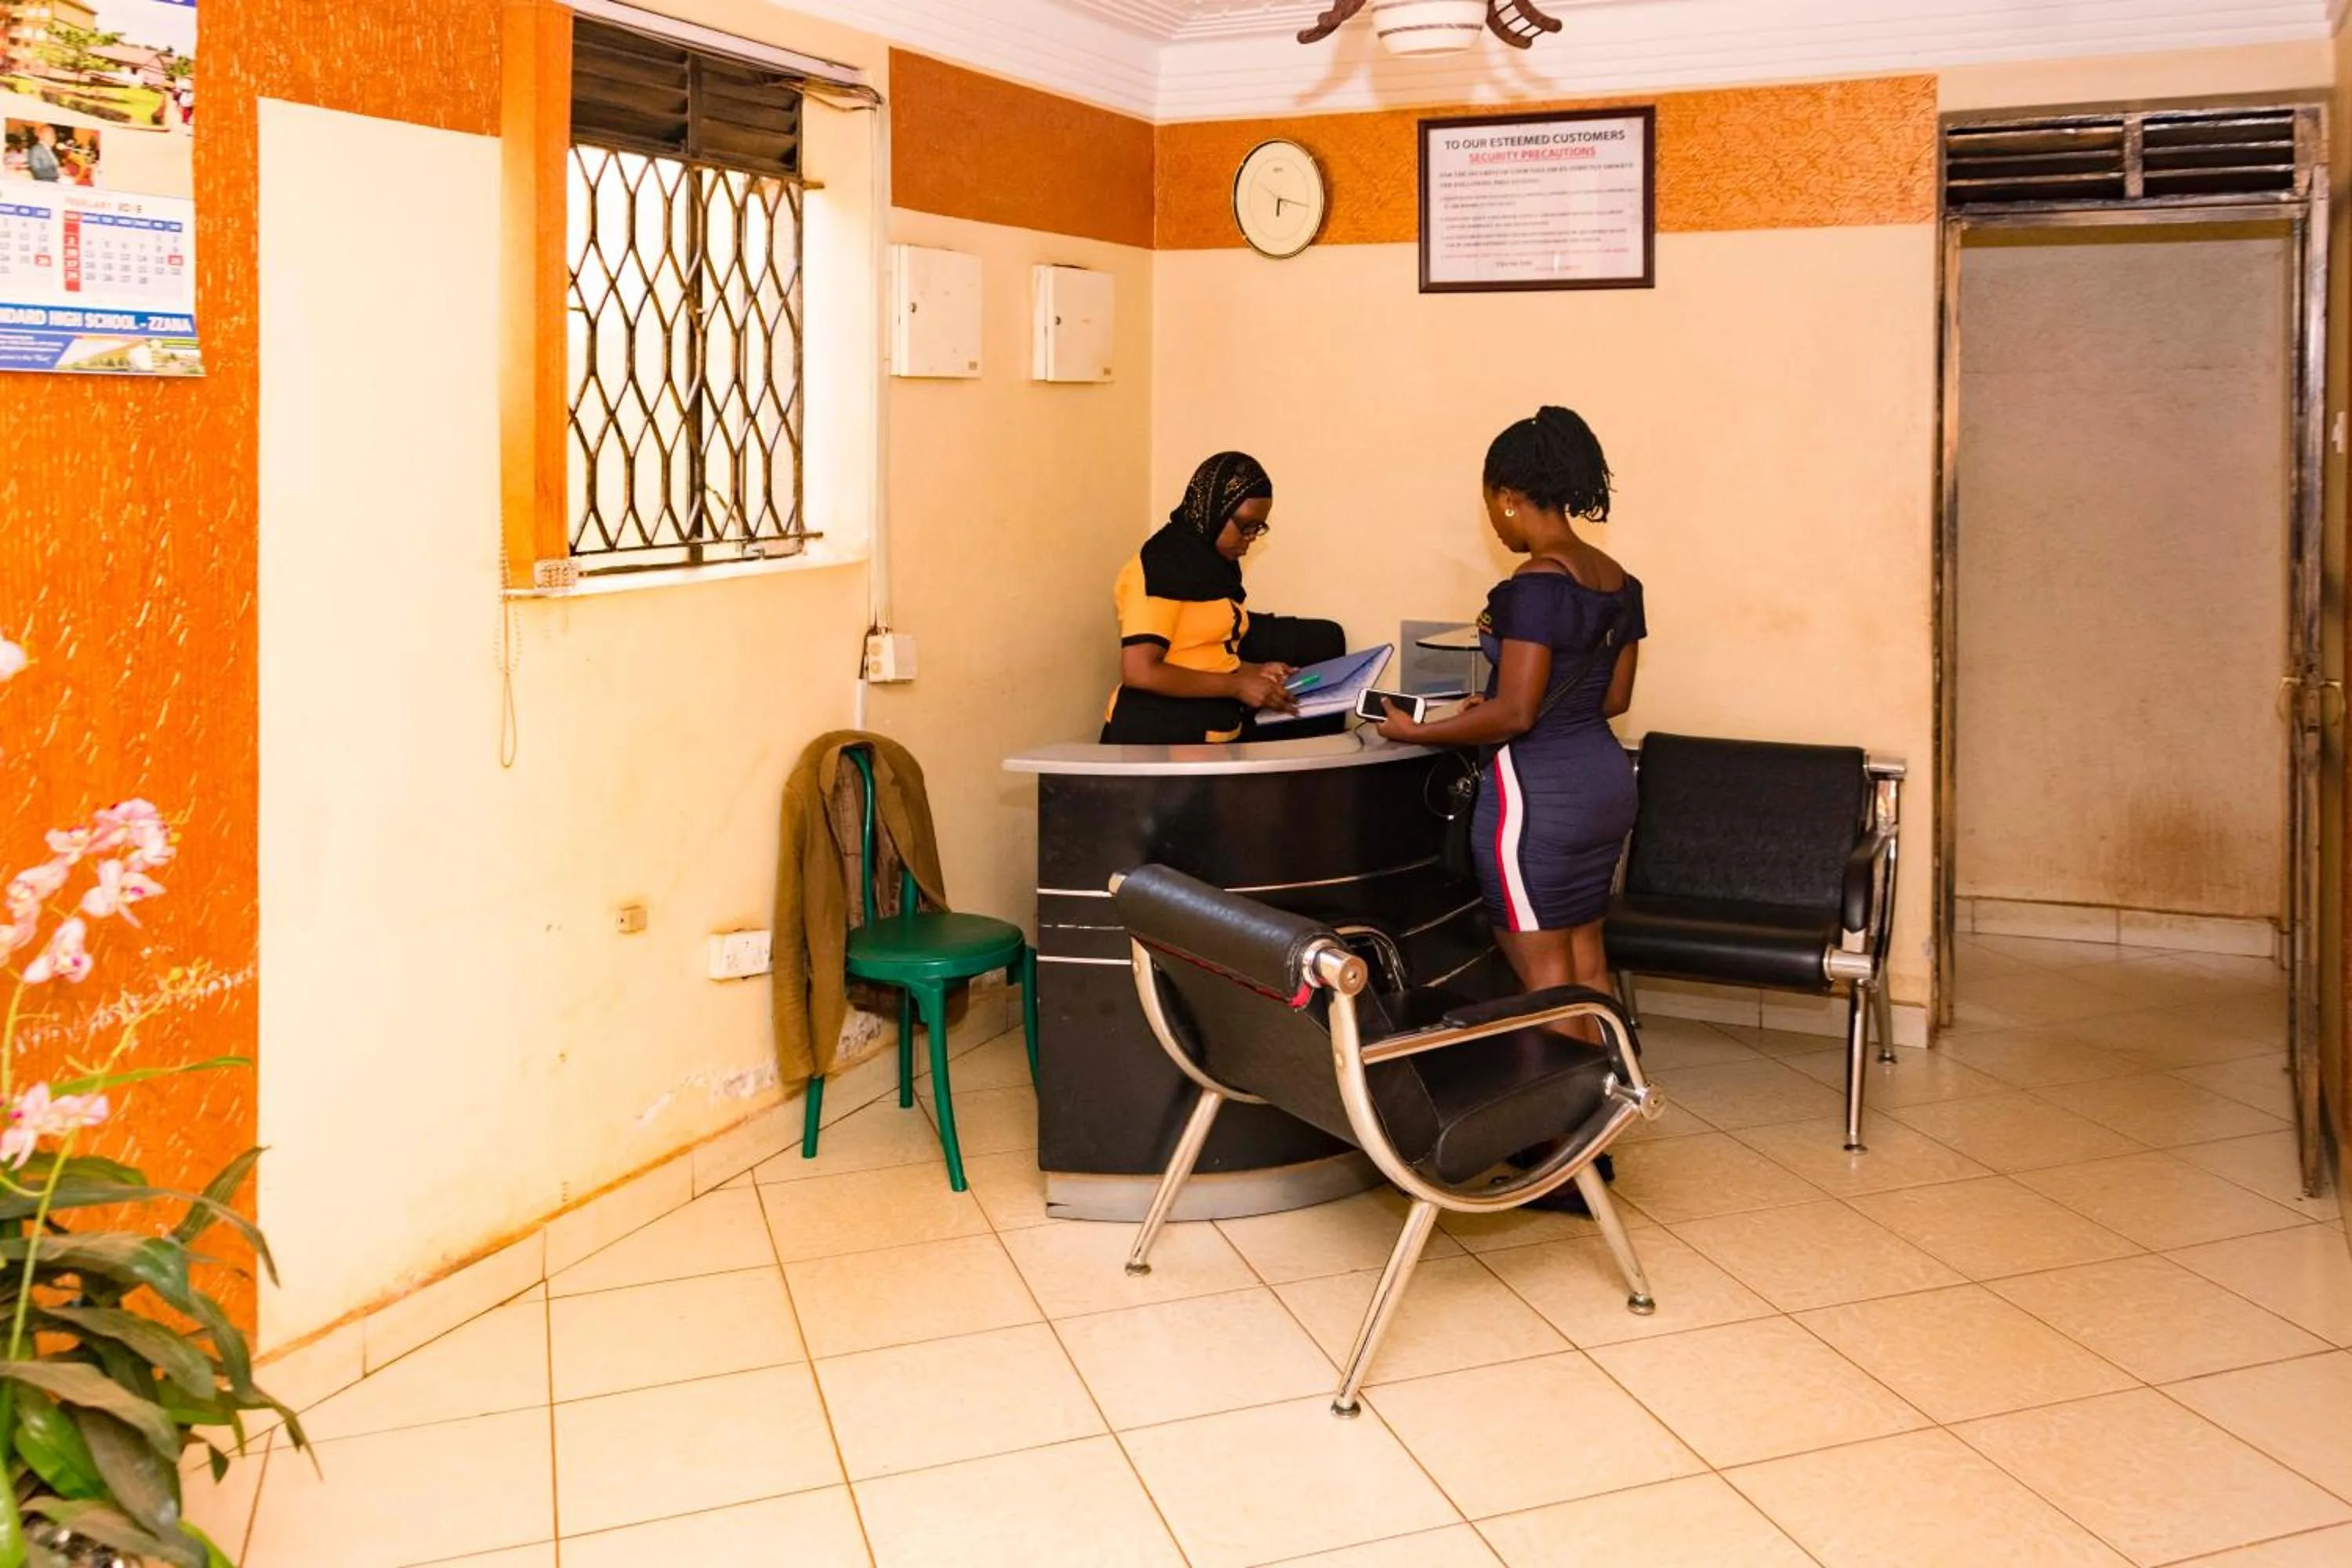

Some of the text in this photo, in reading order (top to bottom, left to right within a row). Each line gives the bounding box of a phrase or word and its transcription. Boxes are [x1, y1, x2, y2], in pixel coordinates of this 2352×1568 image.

[1445, 130, 1625, 151] TO OUR ESTEEMED CUSTOMERS
[1469, 146, 1596, 164] SECURITY PRECAUTIONS
[84, 312, 139, 329] SCHOOL
